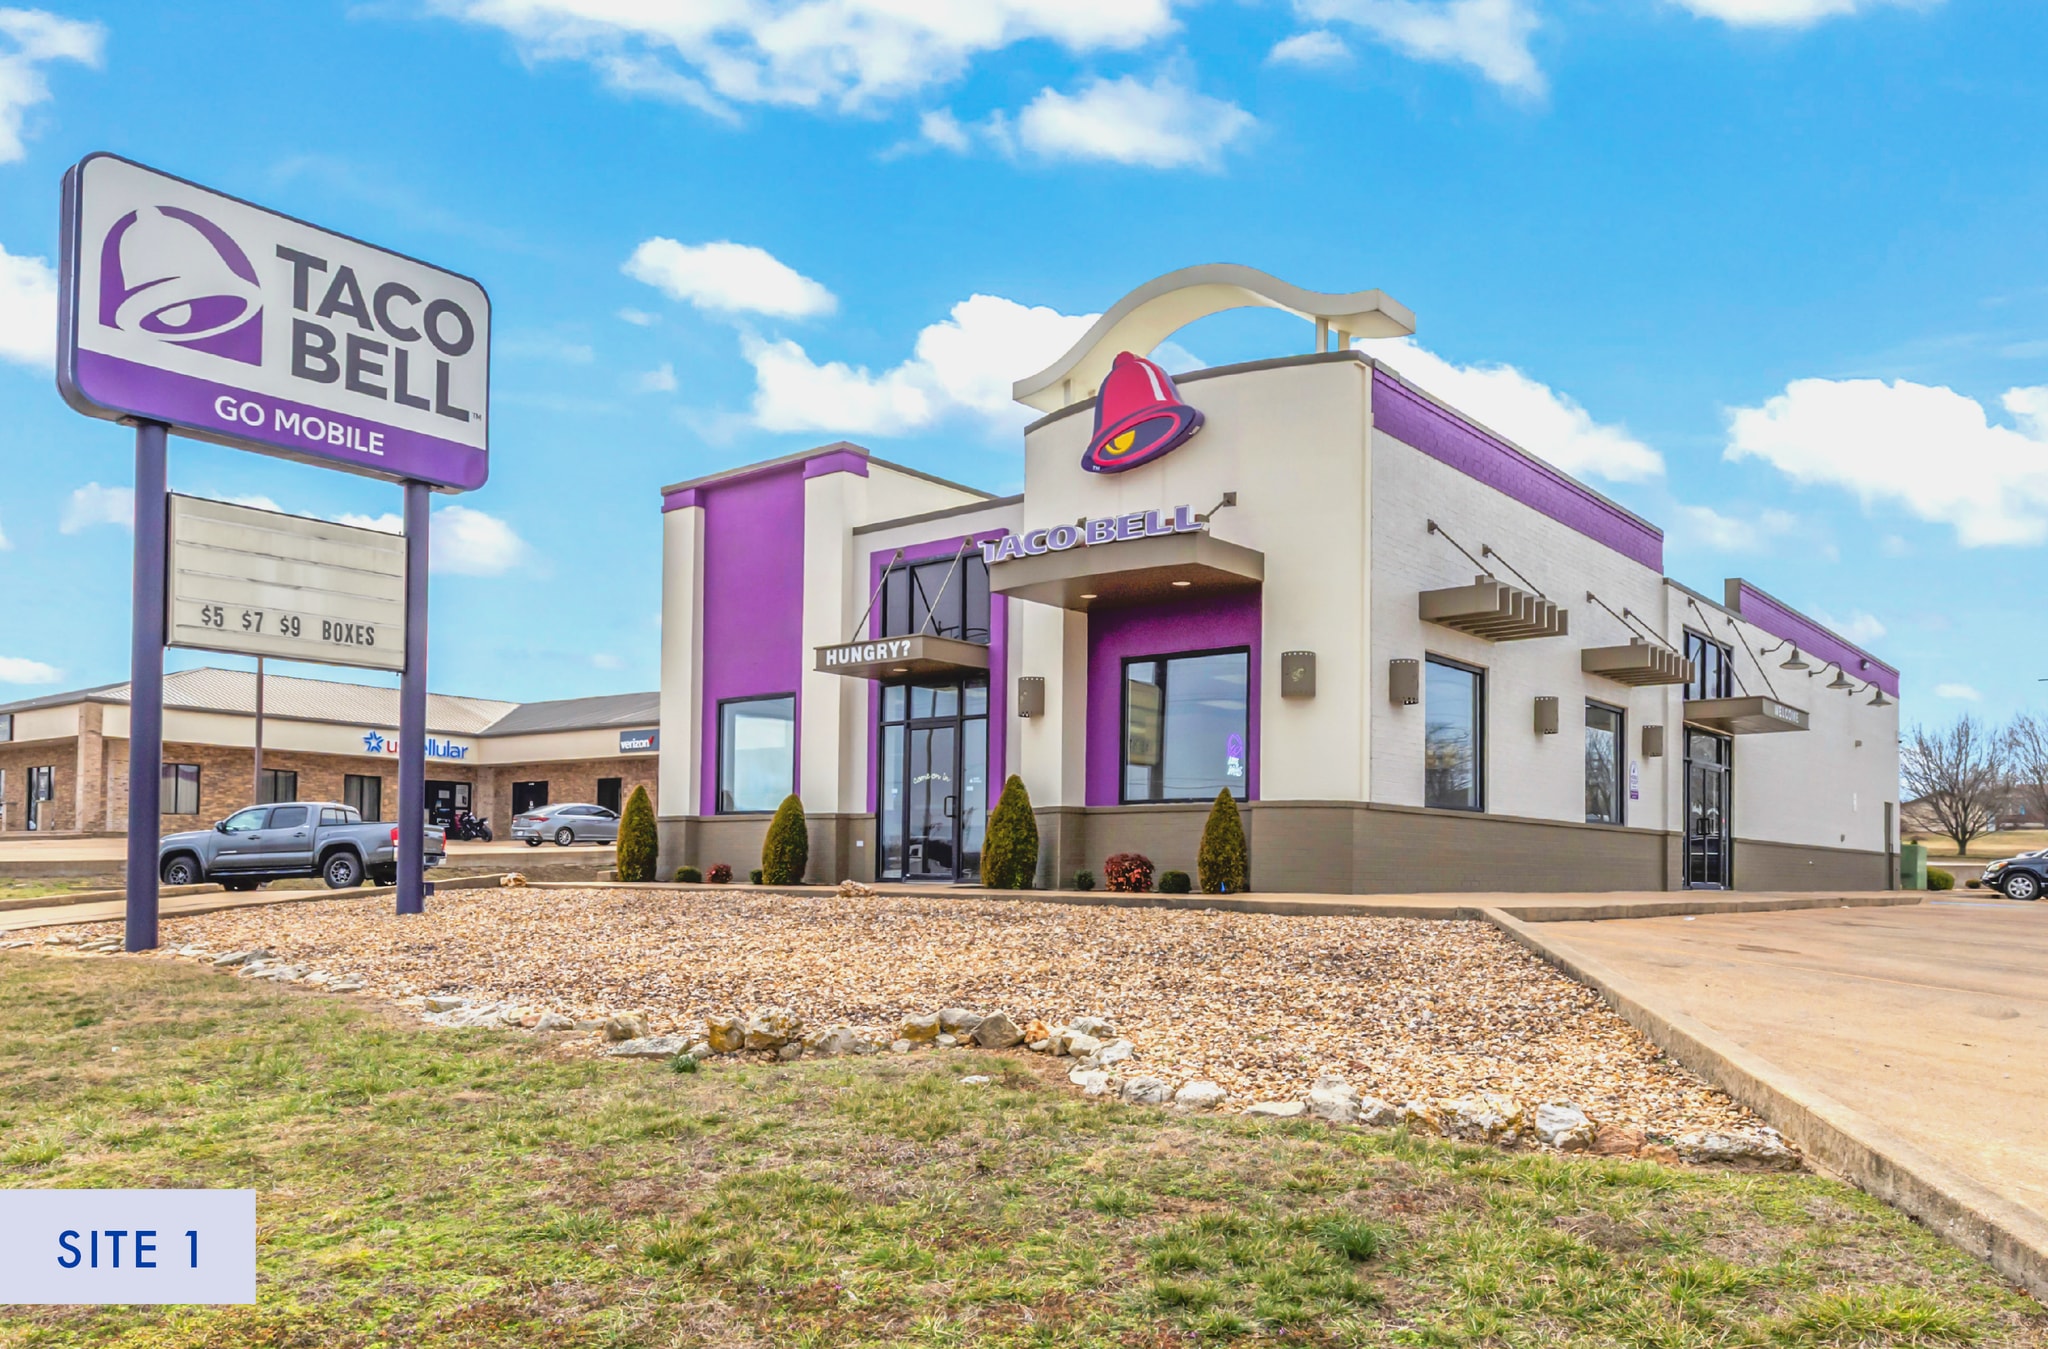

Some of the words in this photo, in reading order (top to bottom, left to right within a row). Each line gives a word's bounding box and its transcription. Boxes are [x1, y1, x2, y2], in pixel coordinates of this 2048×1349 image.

[275, 243, 475, 357] TACO
[291, 317, 470, 423] BELL
[214, 396, 265, 427] GO
[274, 408, 385, 456] MOBILE
[977, 524, 1080, 564] TACO
[1085, 505, 1202, 546] BELL
[201, 604, 224, 628] $5
[241, 610, 264, 633] $7
[279, 614, 301, 638] $9
[322, 620, 375, 646] BOXES
[825, 640, 911, 666] HUNGRY?
[620, 737, 650, 750] verizon
